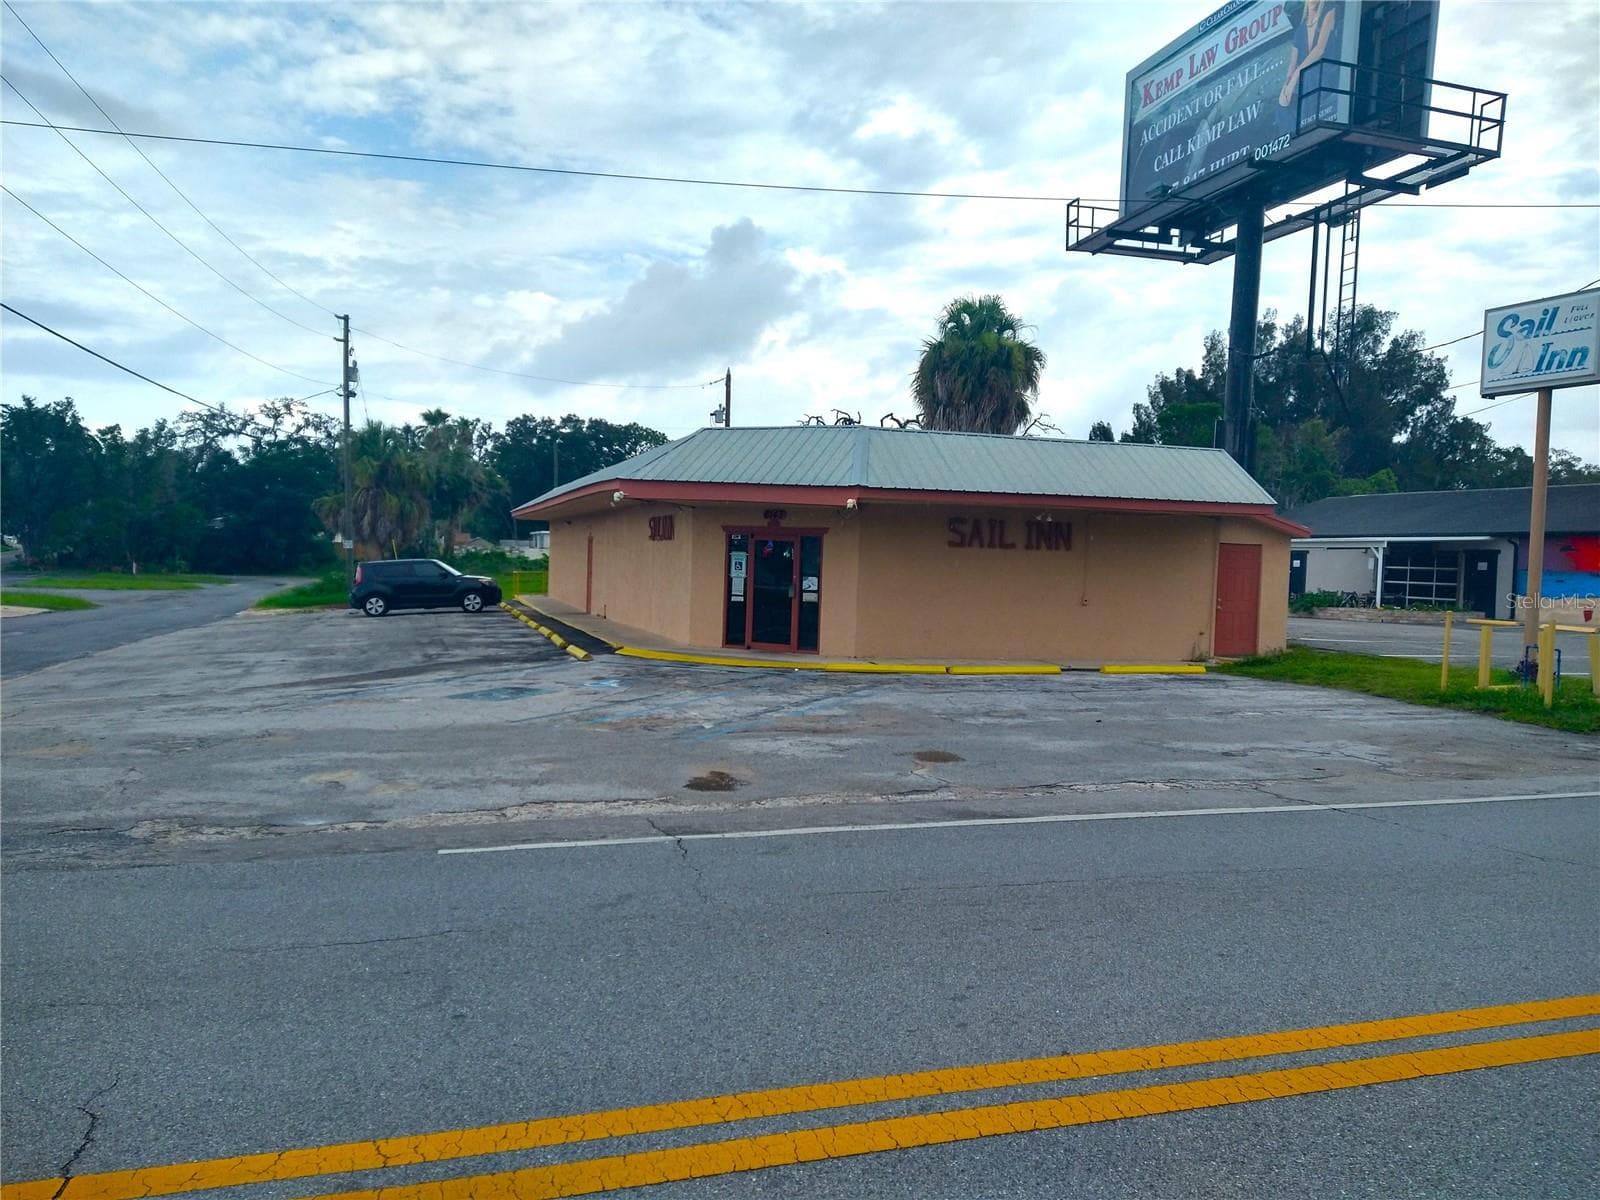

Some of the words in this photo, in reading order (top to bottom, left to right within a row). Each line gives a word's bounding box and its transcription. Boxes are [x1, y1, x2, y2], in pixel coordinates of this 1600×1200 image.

[1142, 67, 1183, 109] KEMP
[1188, 43, 1219, 80] LAW
[1224, 4, 1283, 55] GROUP
[1140, 97, 1201, 146] ACCIDENT
[1204, 85, 1222, 108] OR
[1154, 143, 1185, 172] CALL
[1187, 121, 1225, 155] KEMP
[1228, 100, 1263, 133] LAW
[1254, 134, 1290, 161] 001472
[1493, 306, 1560, 342] Sail
[1533, 342, 1590, 373] Inn
[947, 518, 1016, 549] SAIL
[1025, 520, 1072, 551] INN
